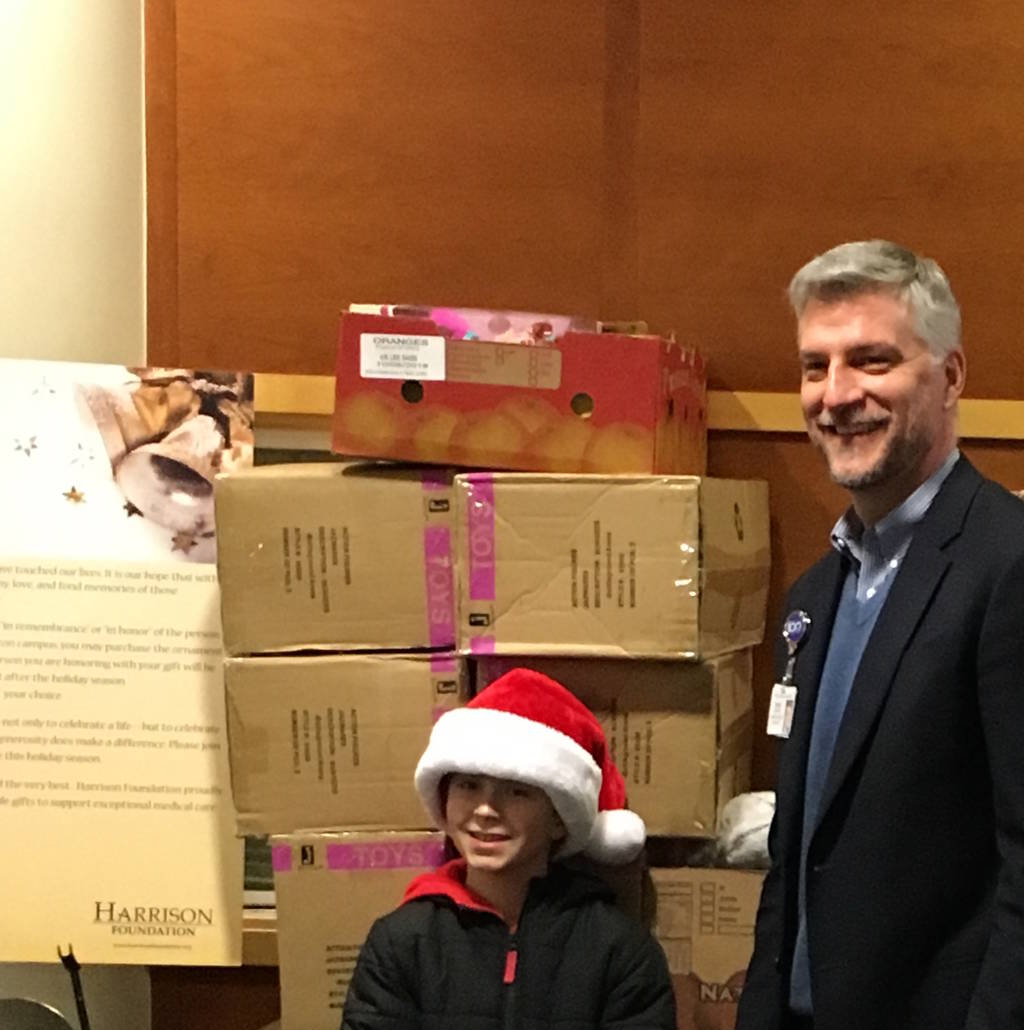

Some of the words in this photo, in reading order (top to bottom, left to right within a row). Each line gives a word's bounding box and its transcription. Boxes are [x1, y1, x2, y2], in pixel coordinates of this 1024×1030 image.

[373, 337, 429, 346] ORANGES
[144, 569, 169, 581] hope
[172, 571, 192, 582] that
[37, 580, 56, 590] and
[85, 583, 134, 594] memories
[137, 583, 150, 593] of
[431, 556, 450, 625] TOYS
[166, 627, 182, 637] the
[154, 644, 170, 654] the
[63, 658, 110, 670] honoring
[113, 659, 137, 670] with
[139, 661, 162, 672] your
[183, 661, 201, 672] will
[4, 672, 30, 682] after
[32, 672, 49, 681] the
[51, 673, 88, 685] holiday
[4, 690, 26, 699] your
[22, 717, 44, 729] only
[46, 718, 57, 728] to
[59, 718, 107, 730] celebrate
[116, 720, 131, 731] life
[142, 721, 158, 731] but
[161, 723, 173, 732] to
[0, 734, 48, 746] enerosity
[50, 735, 73, 746] does
[75, 737, 103, 747] make
[169, 739, 199, 750] Please
[5, 752, 24, 761] this
[26, 752, 63, 764] holiday
[5, 779, 21, 789] the
[23, 781, 47, 792] very
[76, 781, 121, 792] Harrison
[123, 783, 181, 794] Foundation
[11, 796, 35, 807] gifts
[37, 797, 48, 806] to
[50, 798, 90, 810] support
[93, 800, 151, 812] exceptional
[355, 848, 424, 866] TOYS
[111, 926, 196, 937] FOUNDATION
